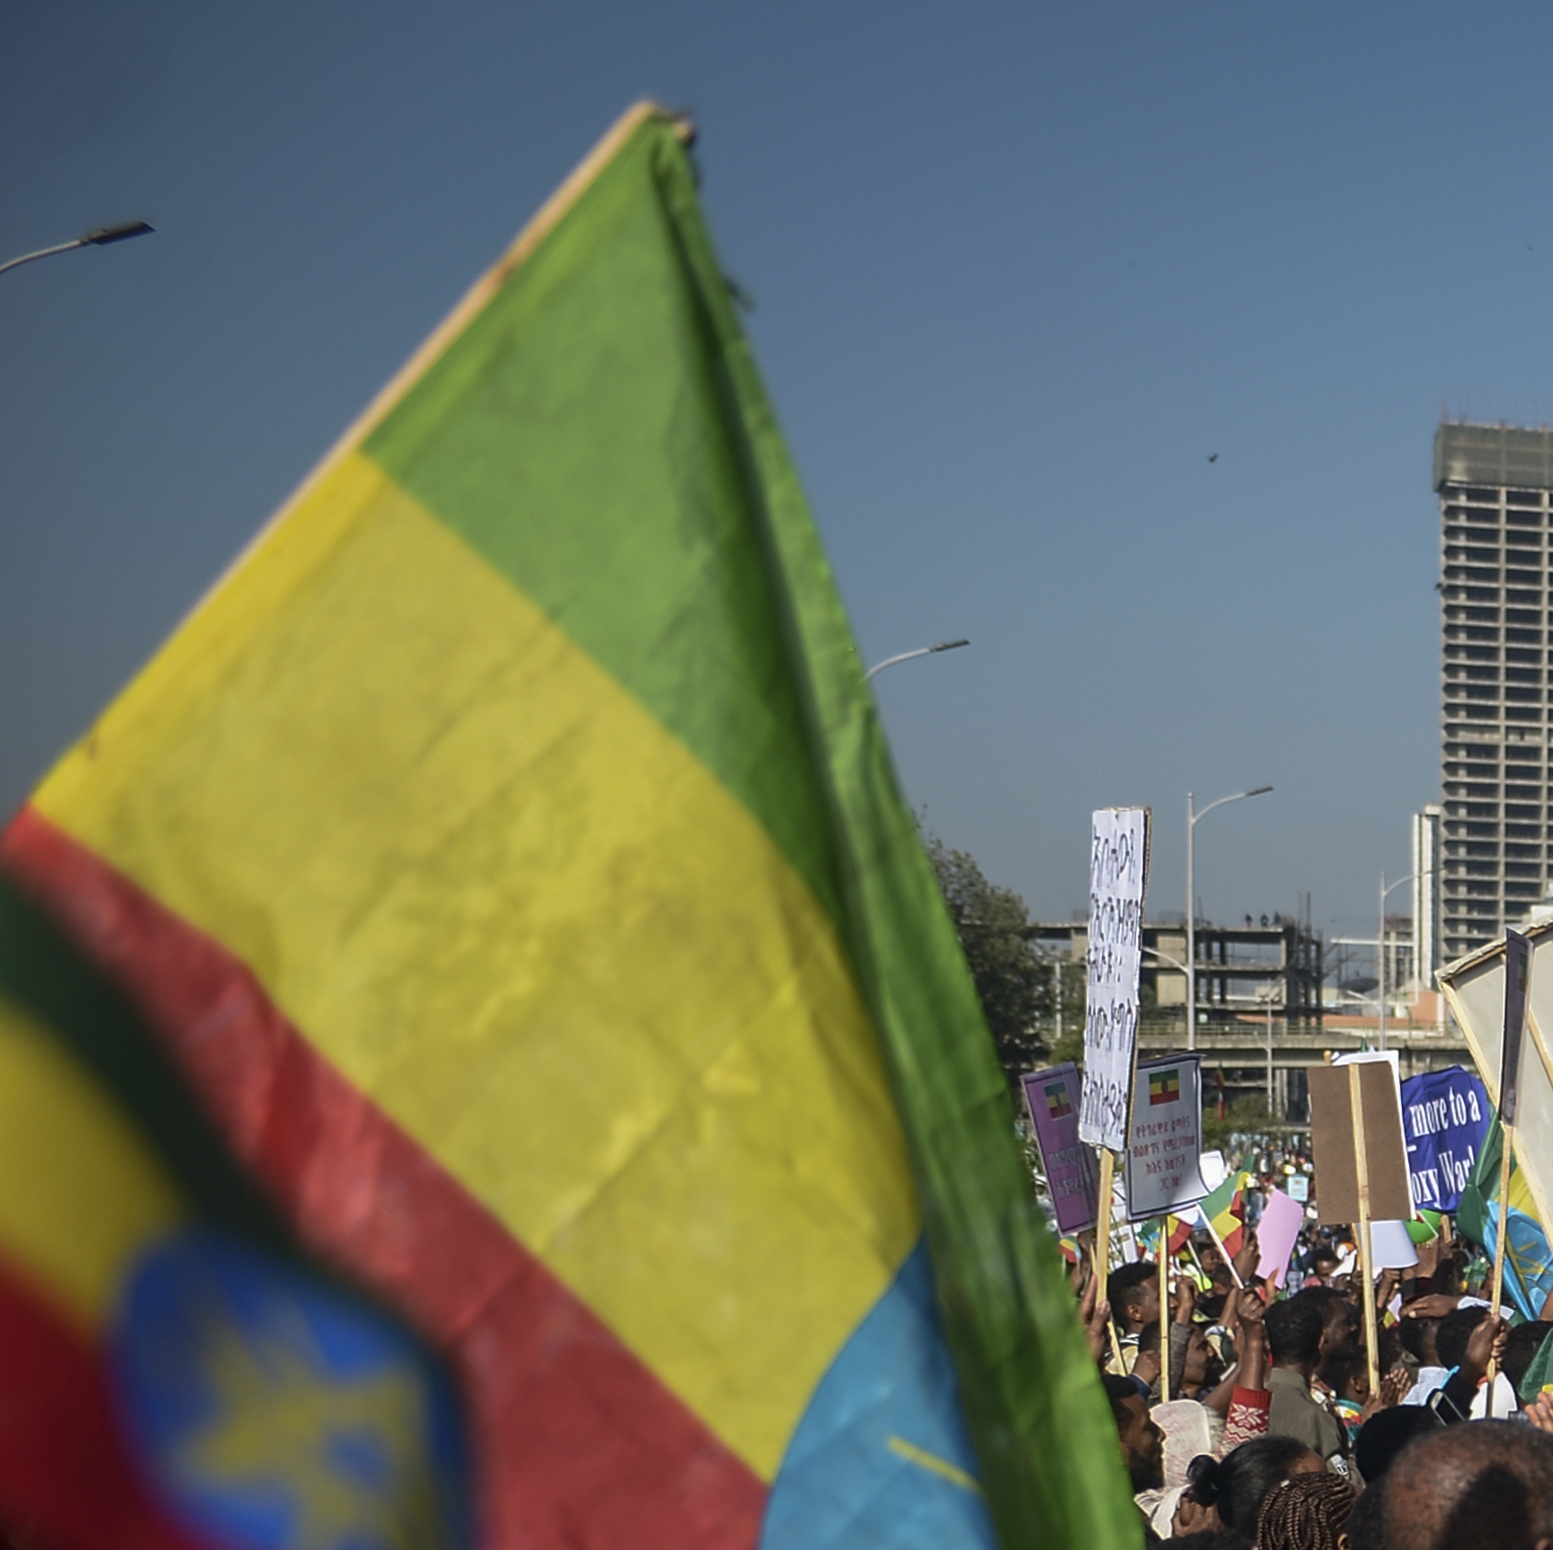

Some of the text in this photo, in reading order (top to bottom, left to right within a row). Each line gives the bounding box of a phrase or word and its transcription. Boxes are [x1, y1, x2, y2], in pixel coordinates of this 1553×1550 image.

[1409, 1086, 1481, 1138] more to a
[1412, 1168, 1442, 1209] oxy
